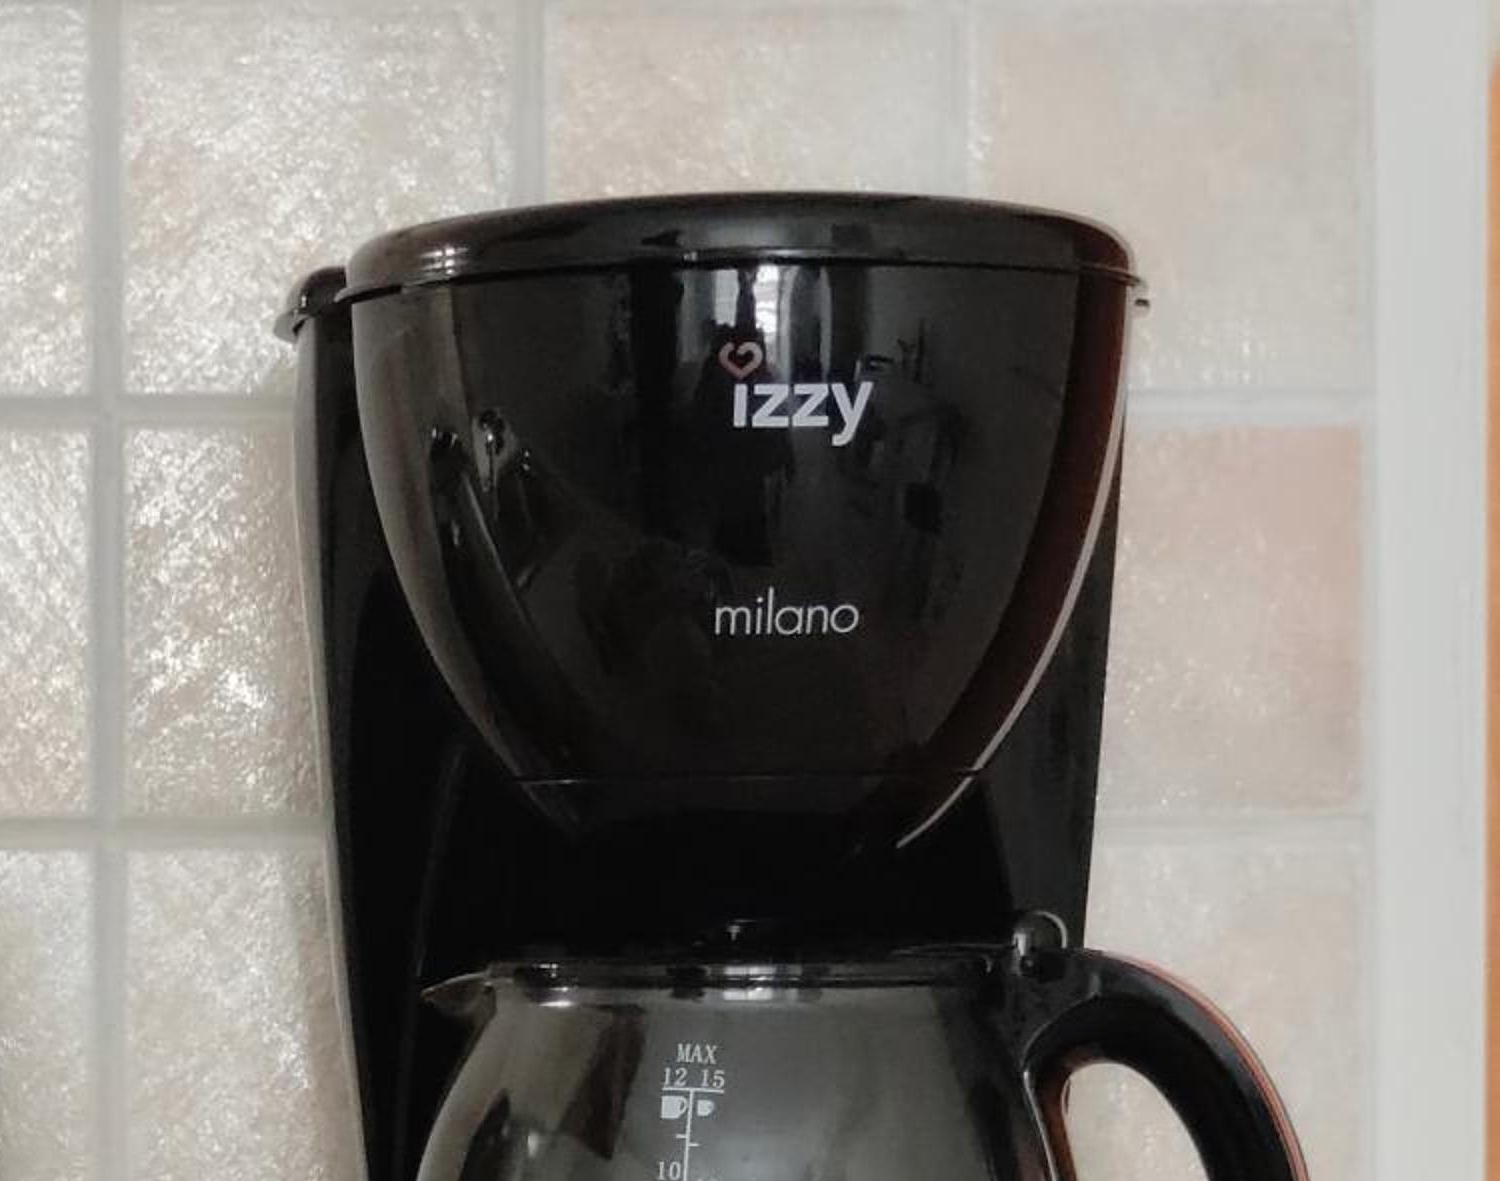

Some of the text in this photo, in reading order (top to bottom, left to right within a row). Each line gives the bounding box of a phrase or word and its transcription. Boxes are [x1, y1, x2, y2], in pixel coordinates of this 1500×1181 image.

[732, 380, 875, 447] izzy
[714, 585, 860, 635] milano
[677, 1043, 717, 1065] MAX
[663, 1066, 725, 1089] 12 15
[656, 1161, 682, 1181] 10
